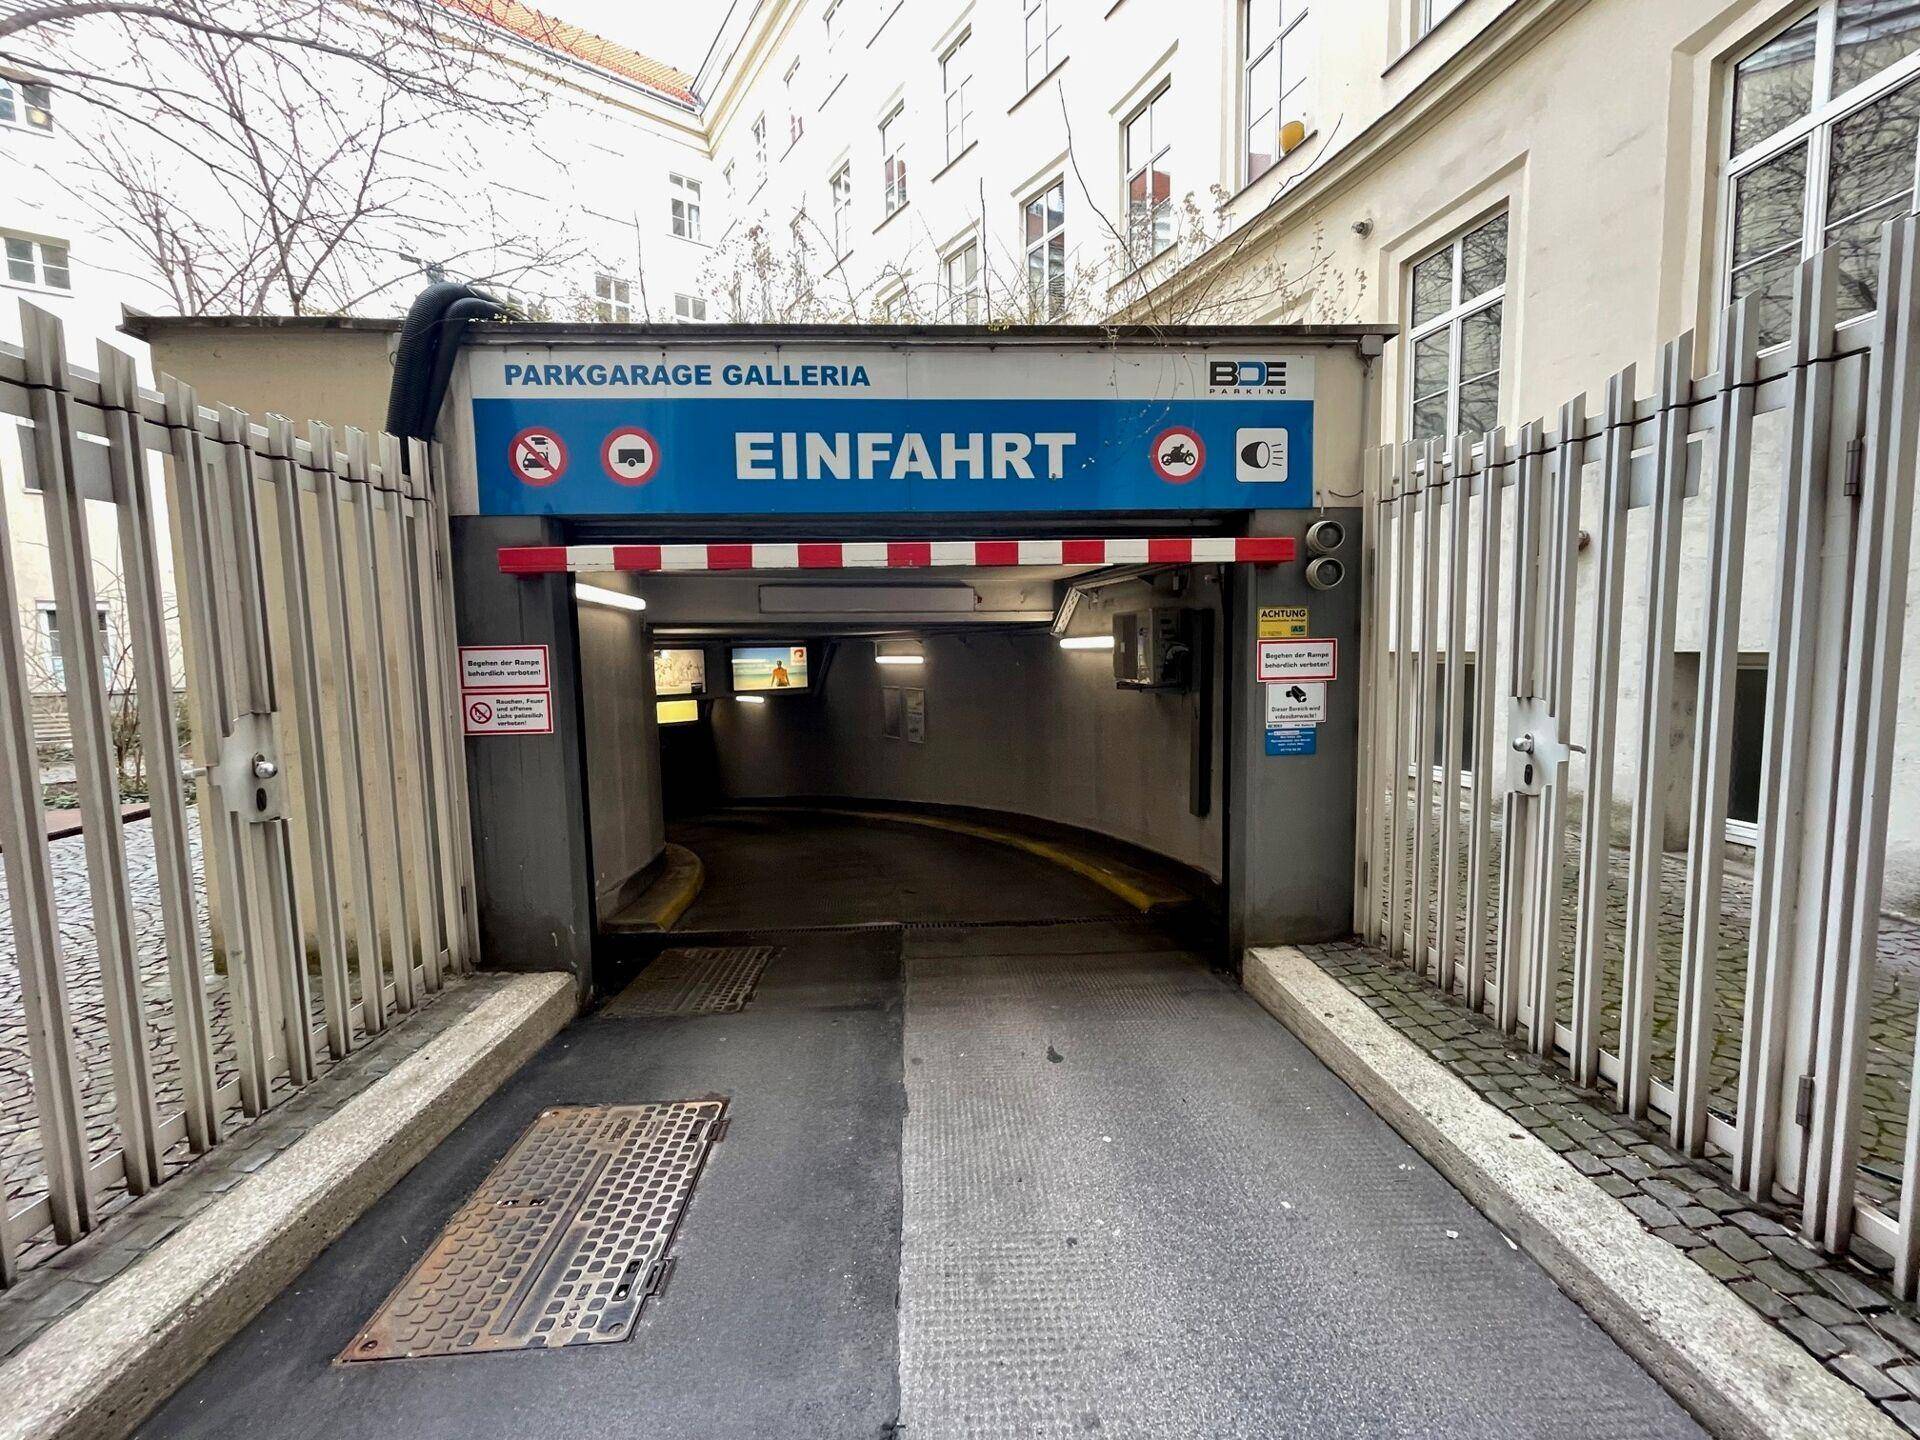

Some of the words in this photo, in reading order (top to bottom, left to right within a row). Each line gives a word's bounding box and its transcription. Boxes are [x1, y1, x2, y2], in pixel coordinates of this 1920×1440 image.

[504, 364, 713, 386] PARKGARAGE
[722, 365, 871, 387] GALLERIA
[735, 431, 1077, 481] EINFAHRT
[1261, 609, 1306, 618] ACHTUNG
[514, 659, 540, 667] Rampe
[1265, 652, 1293, 660] Begehen
[574, 1283, 593, 1301] EN
[560, 1303, 582, 1329] 124
